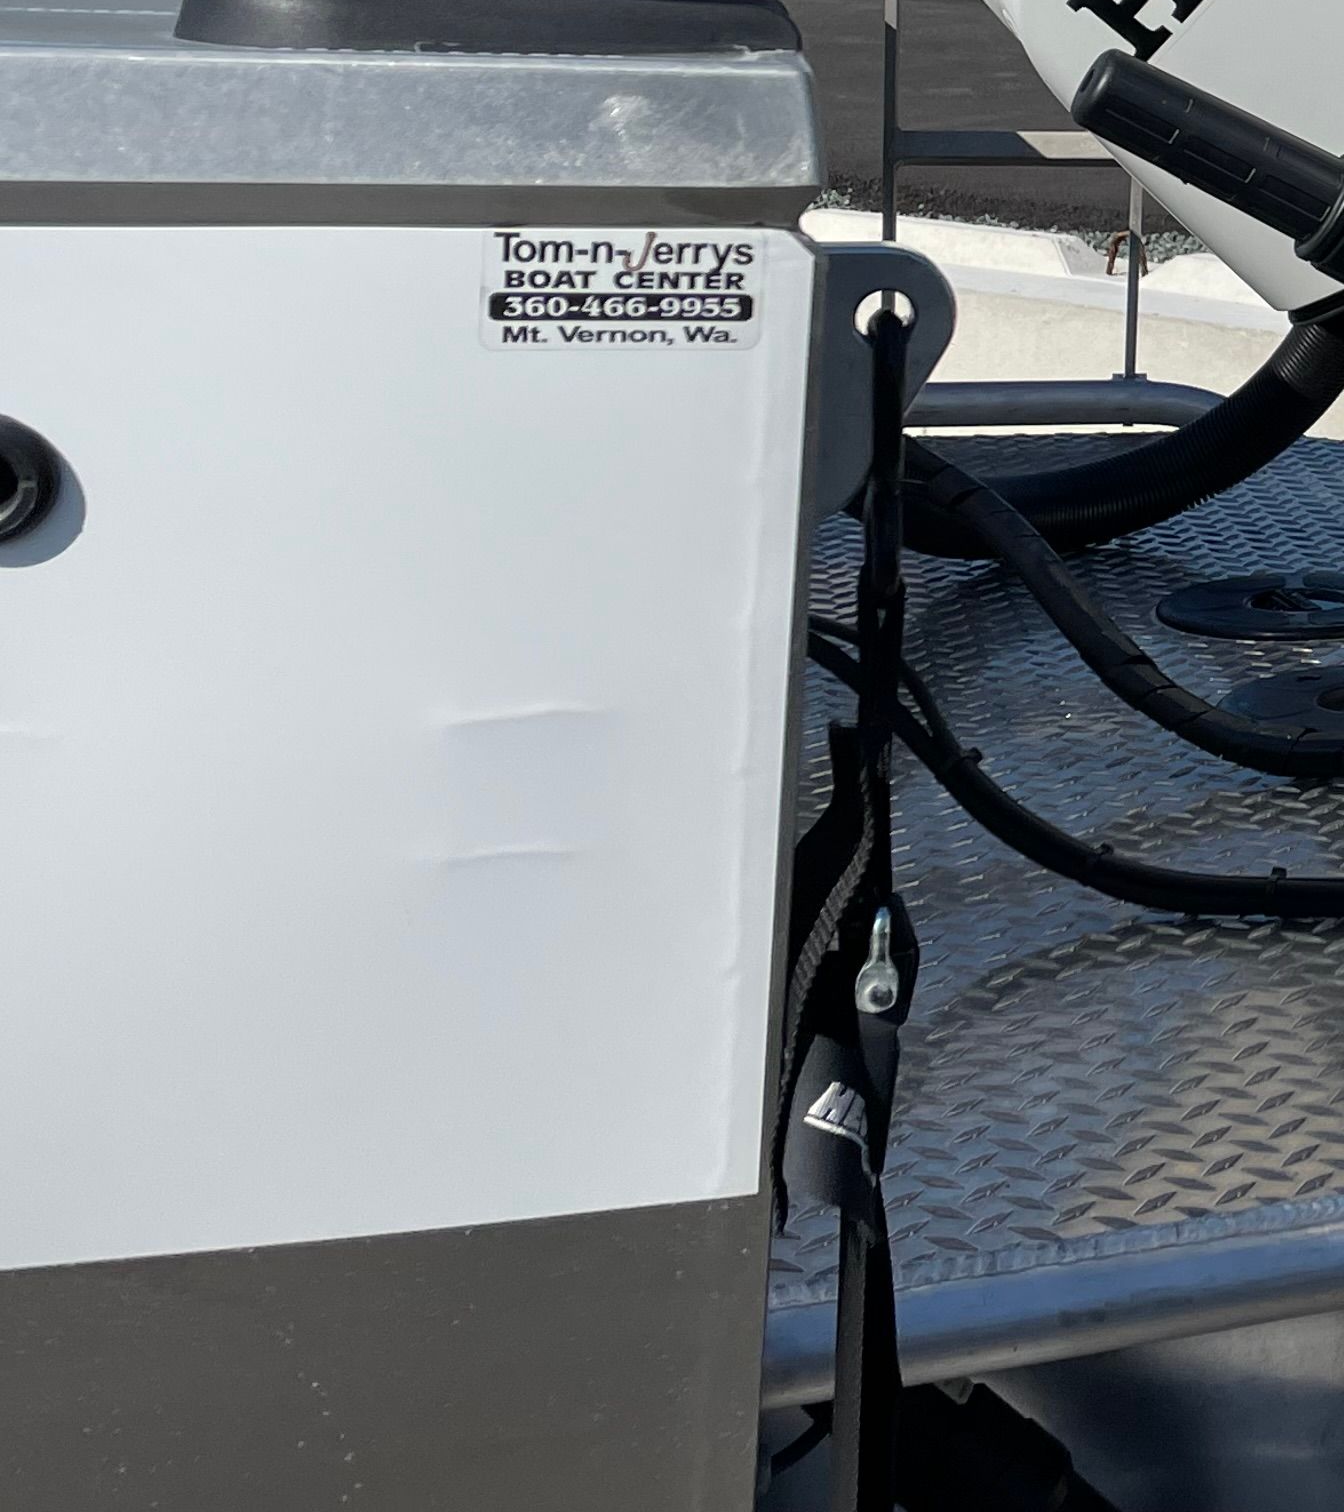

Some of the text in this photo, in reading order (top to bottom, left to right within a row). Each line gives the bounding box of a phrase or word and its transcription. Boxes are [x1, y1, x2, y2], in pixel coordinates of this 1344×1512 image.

[494, 231, 754, 273] Tom-n-Jerrys
[504, 270, 745, 290] BOAT CENTER
[503, 295, 742, 318] 360-466-9955
[502, 326, 738, 346] Mt. Vernon, Wa.
